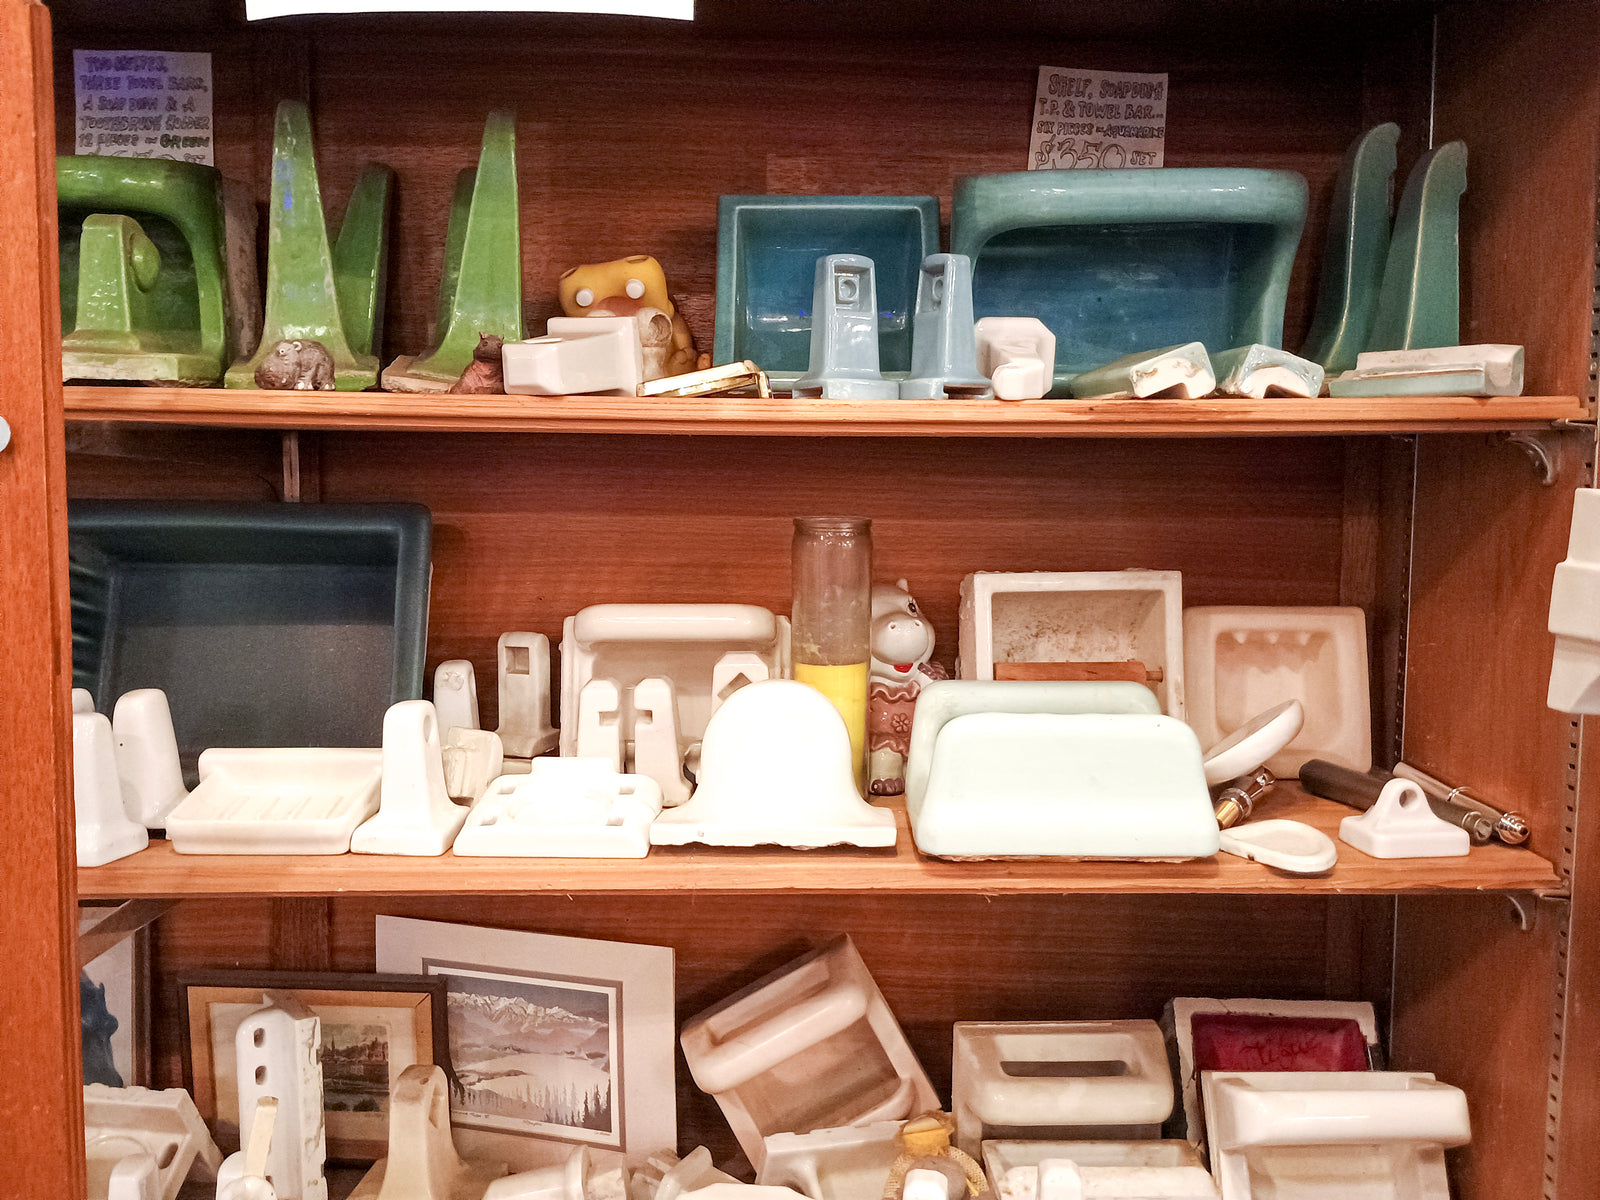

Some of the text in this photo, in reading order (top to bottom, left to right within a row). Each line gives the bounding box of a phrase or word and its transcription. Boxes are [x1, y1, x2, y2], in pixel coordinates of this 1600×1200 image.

[1048, 73, 1094, 99] SHELF,
[166, 95, 177, 111] &
[182, 96, 195, 112] A
[1039, 97, 1061, 115] T.P.
[1062, 100, 1075, 118] &
[1078, 101, 1121, 119] TOWEL
[1037, 121, 1055, 134] SIX
[1057, 122, 1094, 135] PIECES
[78, 133, 93, 147] 12
[160, 133, 210, 149] GREEN
[1130, 150, 1157, 166] SET
